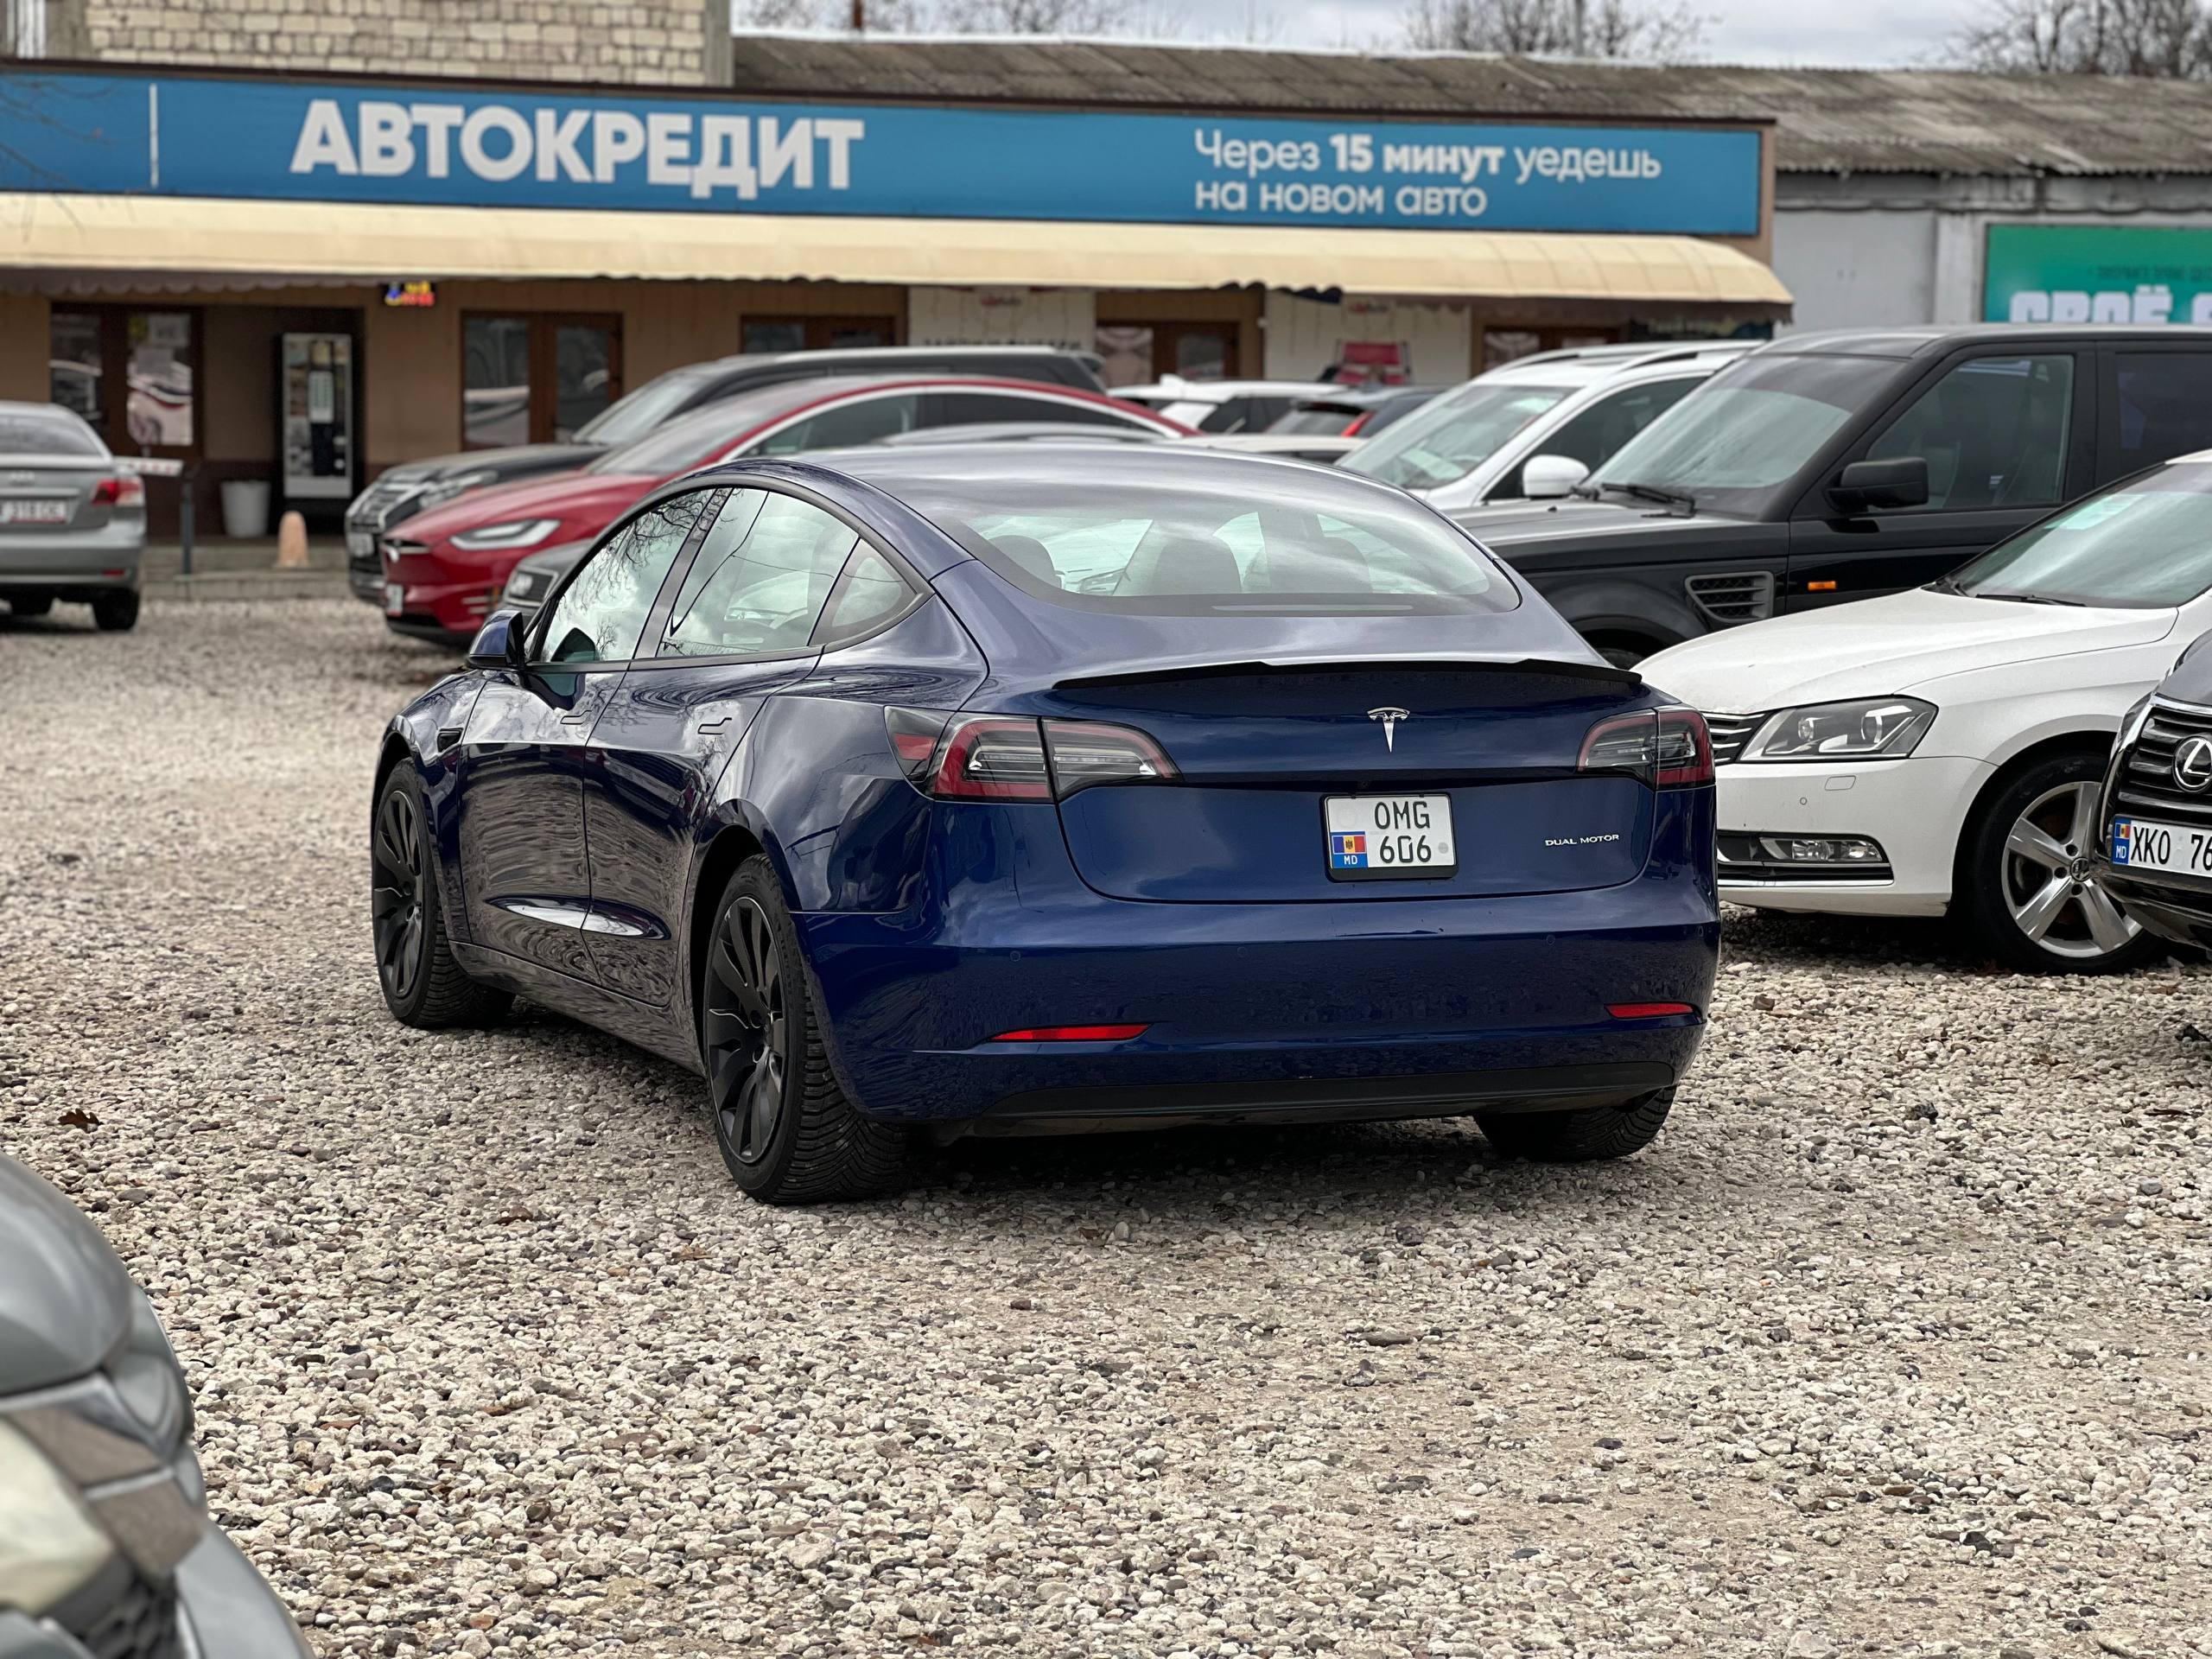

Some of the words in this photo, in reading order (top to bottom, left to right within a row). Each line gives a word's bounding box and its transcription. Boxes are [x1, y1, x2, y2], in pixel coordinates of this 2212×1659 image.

[289, 99, 865, 200] АВТОКРЕДИТ
[1194, 128, 1321, 179] Через
[1329, 133, 1374, 172] 15
[1383, 143, 1506, 184] минут
[1513, 146, 1662, 185] уедешь
[1195, 181, 1248, 211] на
[1259, 182, 1384, 214] новом
[1395, 185, 1488, 216] авто
[1374, 800, 1431, 830] OMG
[1379, 835, 1432, 864] 606
[1580, 834, 1620, 844] MOTOR
[2115, 845, 2127, 859] MD
[1344, 855, 1358, 865] MD
